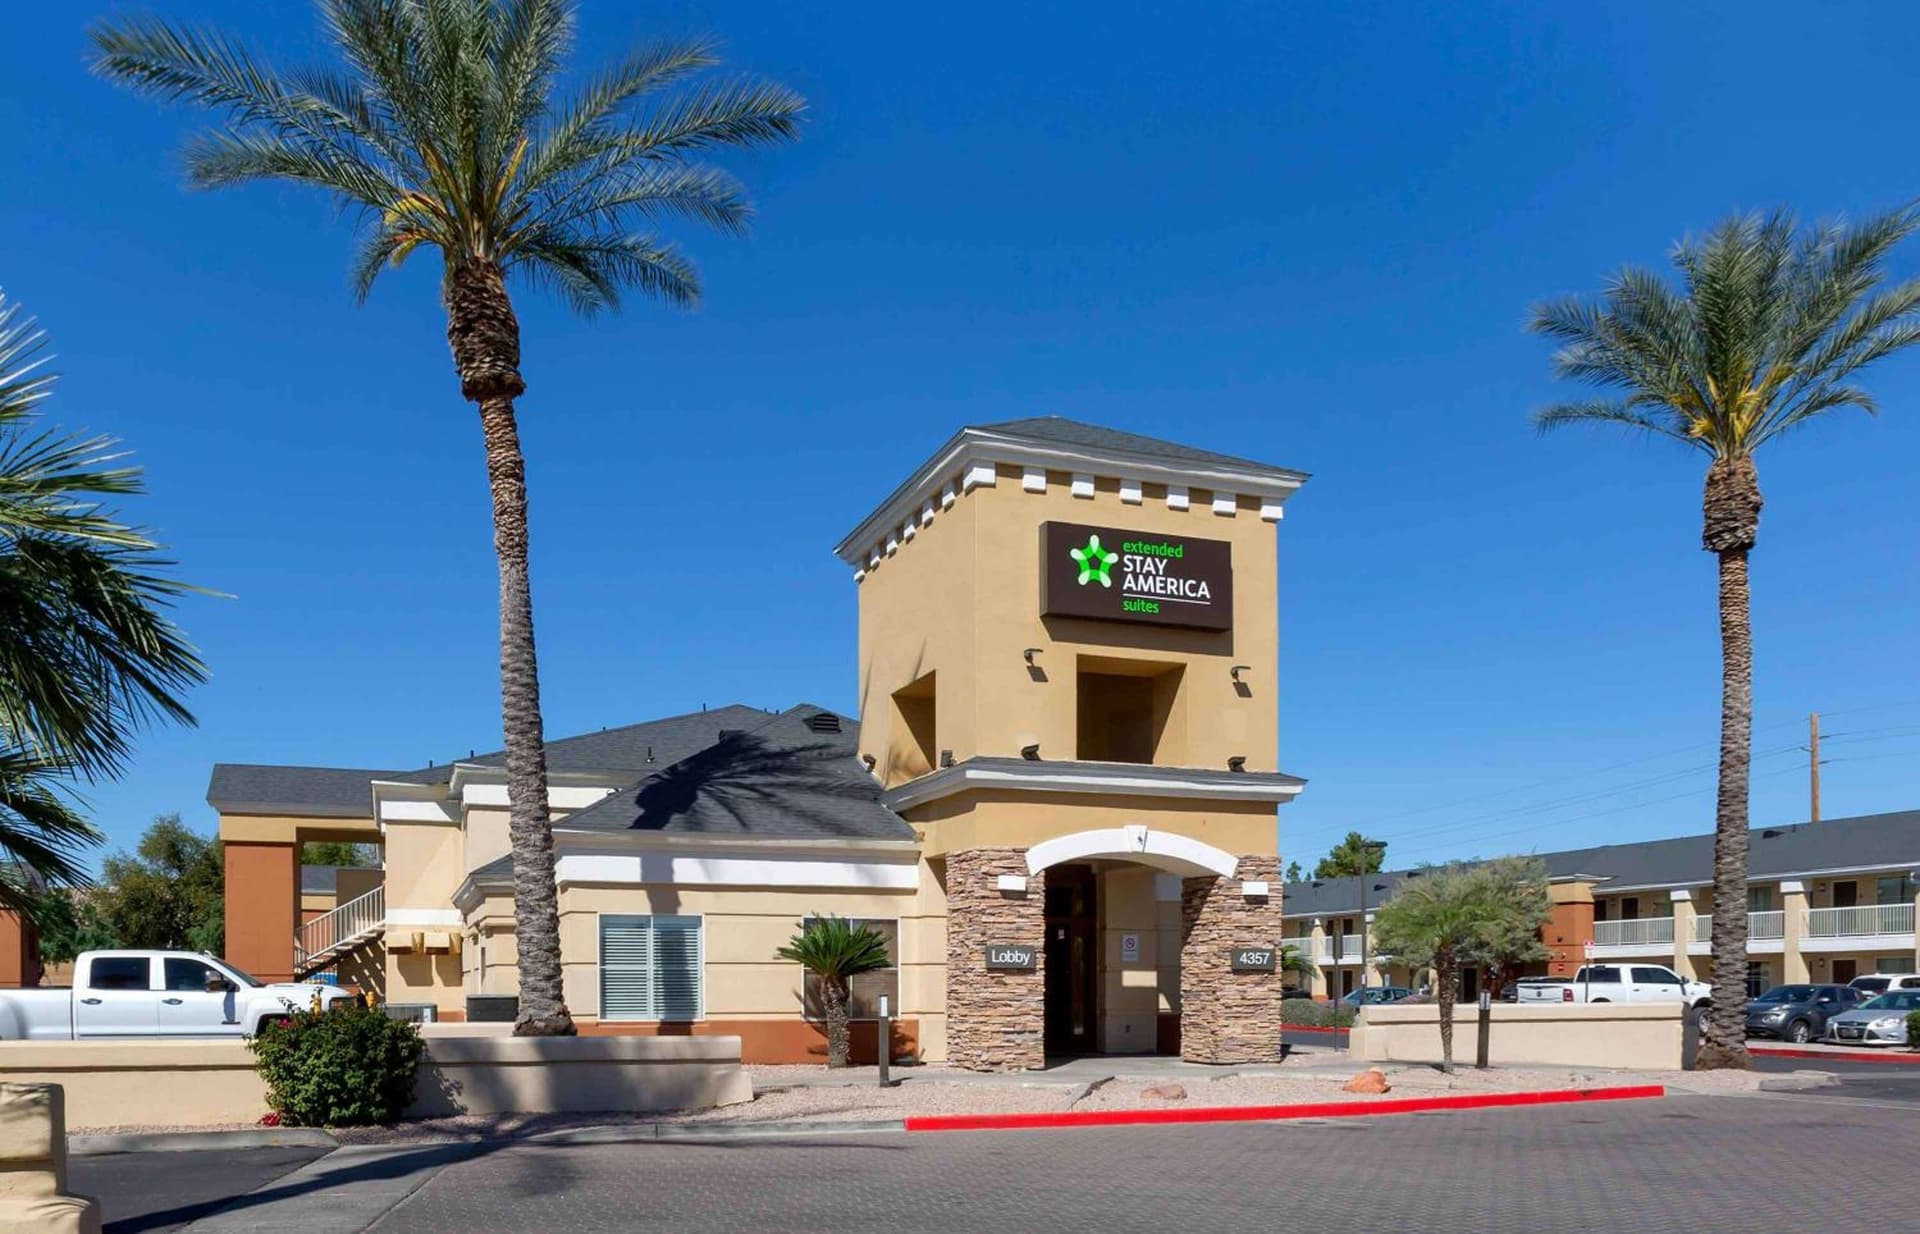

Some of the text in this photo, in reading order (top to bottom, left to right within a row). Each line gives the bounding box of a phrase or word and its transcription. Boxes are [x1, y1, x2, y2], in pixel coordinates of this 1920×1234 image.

[1123, 541, 1183, 558] extended
[1123, 555, 1168, 575] STAY
[1123, 574, 1211, 599] AMERICA
[1123, 600, 1160, 614] suites
[991, 949, 1030, 966] Lobby
[1239, 952, 1270, 965] 4357
